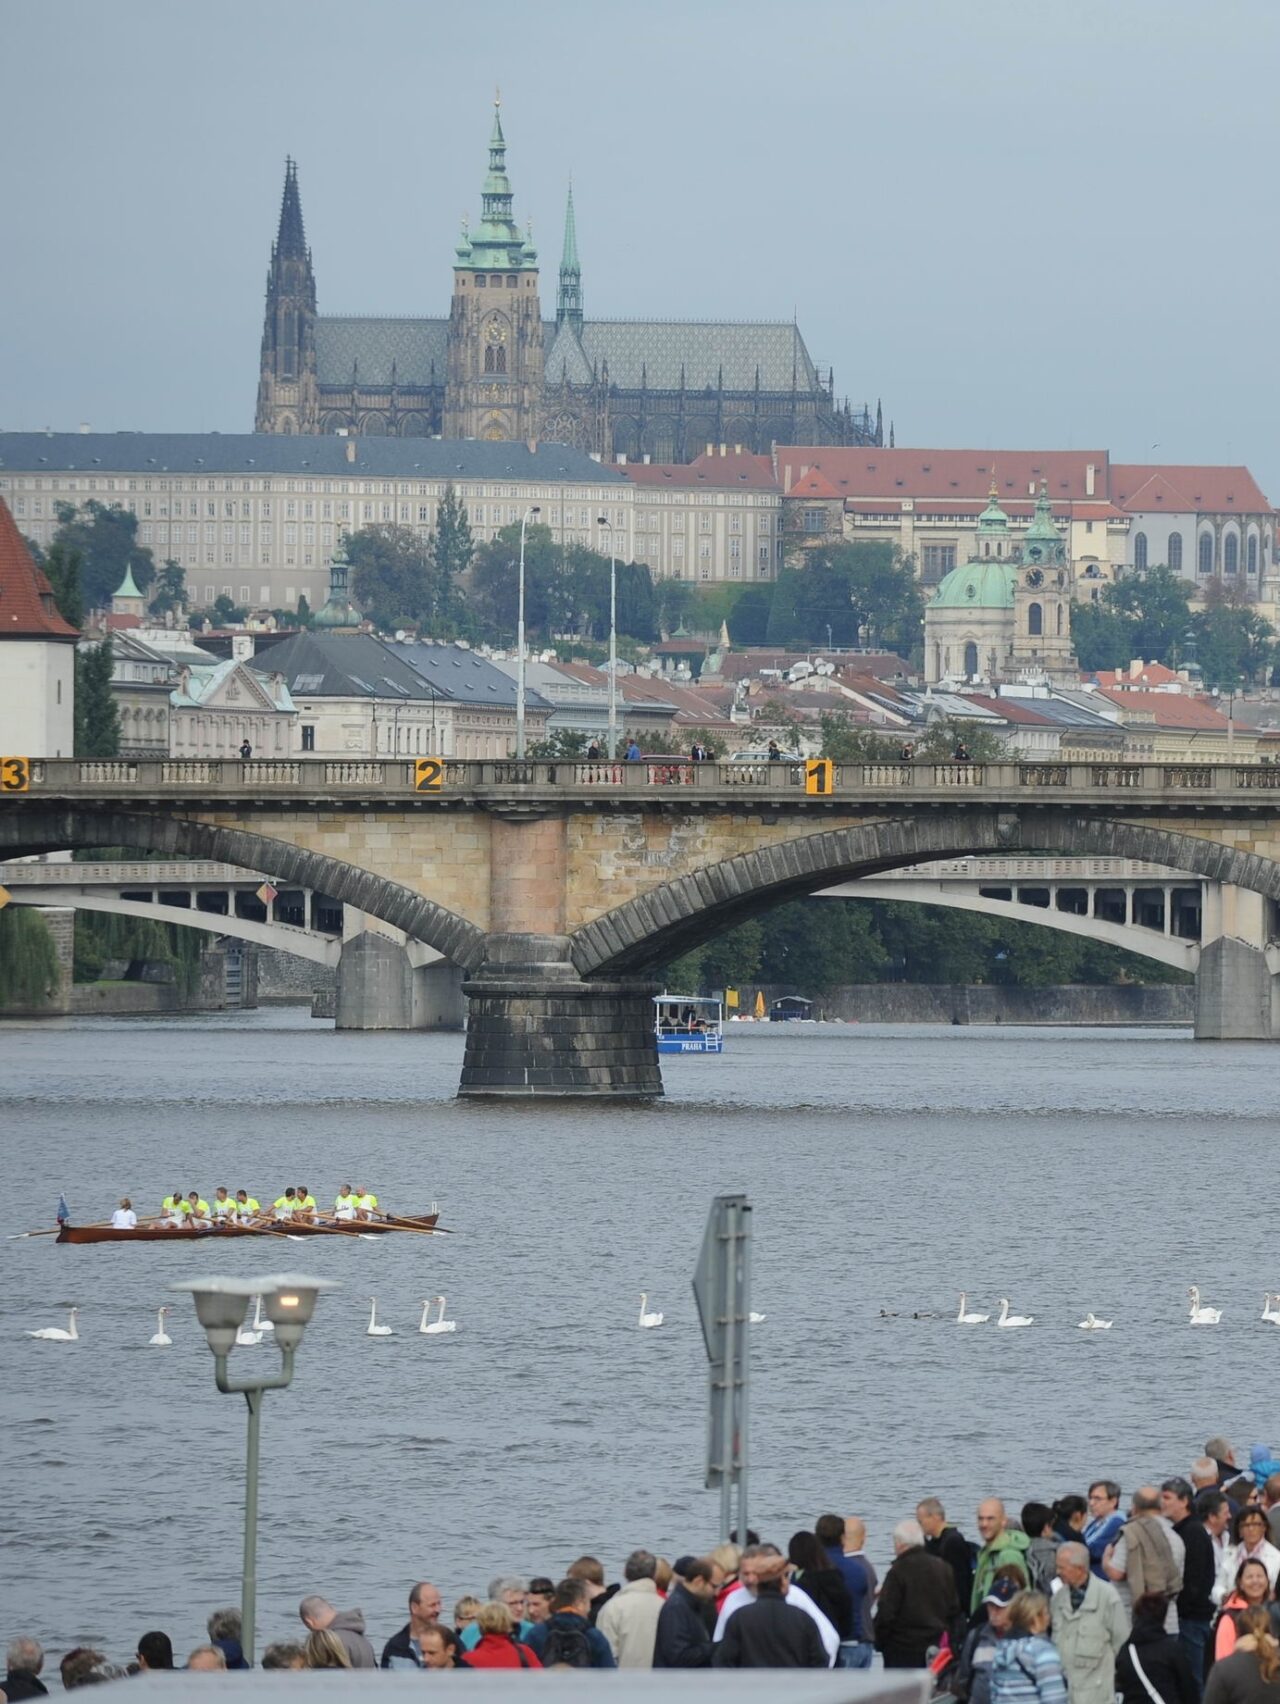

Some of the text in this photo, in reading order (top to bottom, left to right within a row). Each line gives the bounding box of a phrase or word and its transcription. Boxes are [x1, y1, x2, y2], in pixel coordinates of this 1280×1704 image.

[3, 759, 27, 790] 3
[417, 760, 442, 791] 2
[808, 762, 826, 793] 1
[681, 1042, 703, 1051] PRAHA
